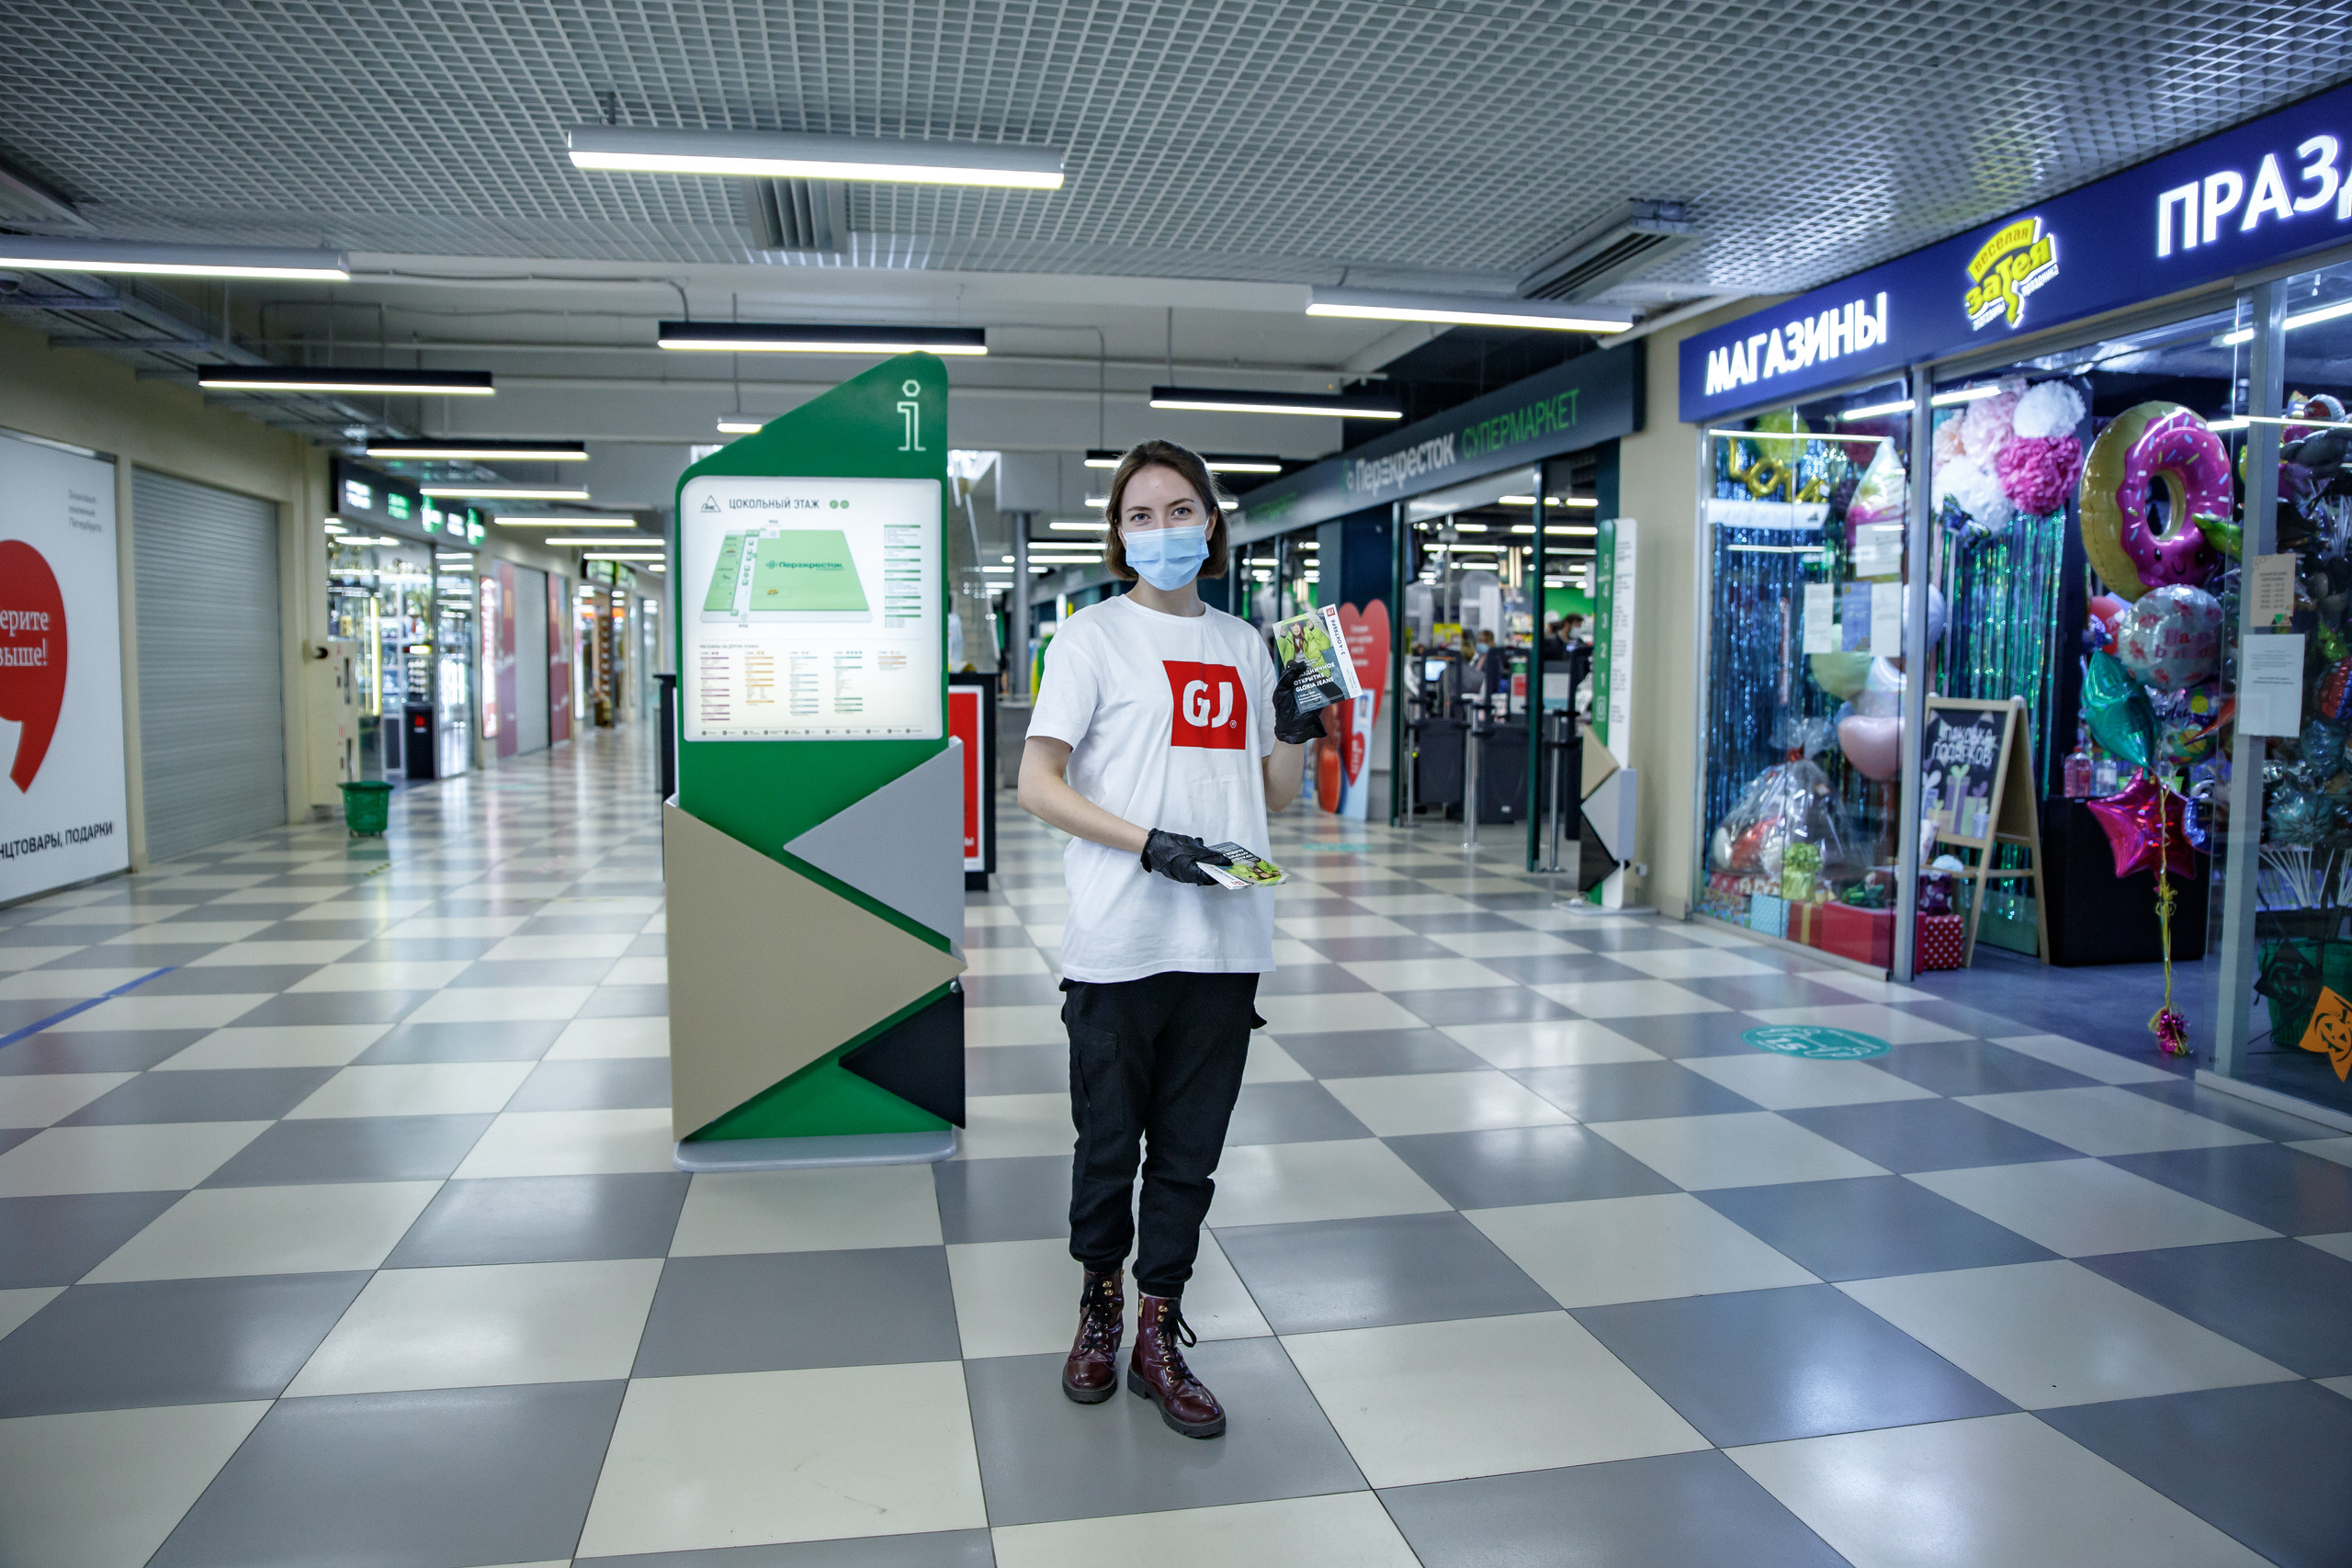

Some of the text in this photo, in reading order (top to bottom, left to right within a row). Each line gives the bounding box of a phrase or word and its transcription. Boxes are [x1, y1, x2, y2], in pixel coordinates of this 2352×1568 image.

[1705, 291, 1887, 396] МАГАЗИНЫ
[1462, 389, 1579, 459] СУПЕРМАРКЕТ
[729, 497, 820, 510] ЦОКОЛЬНЫЙ ЭТАЖ
[1601, 614, 1608, 629] 3
[1330, 619, 1342, 645] ОКТЯБРЯ
[1600, 643, 1607, 659] 2
[1294, 672, 1325, 686] ОТКРЫТИЕ
[1295, 682, 1317, 693] GLORIA
[1317, 676, 1334, 686] JEANS
[1182, 680, 1234, 728] GJ
[64, 821, 113, 844] ПОДАРКИ
